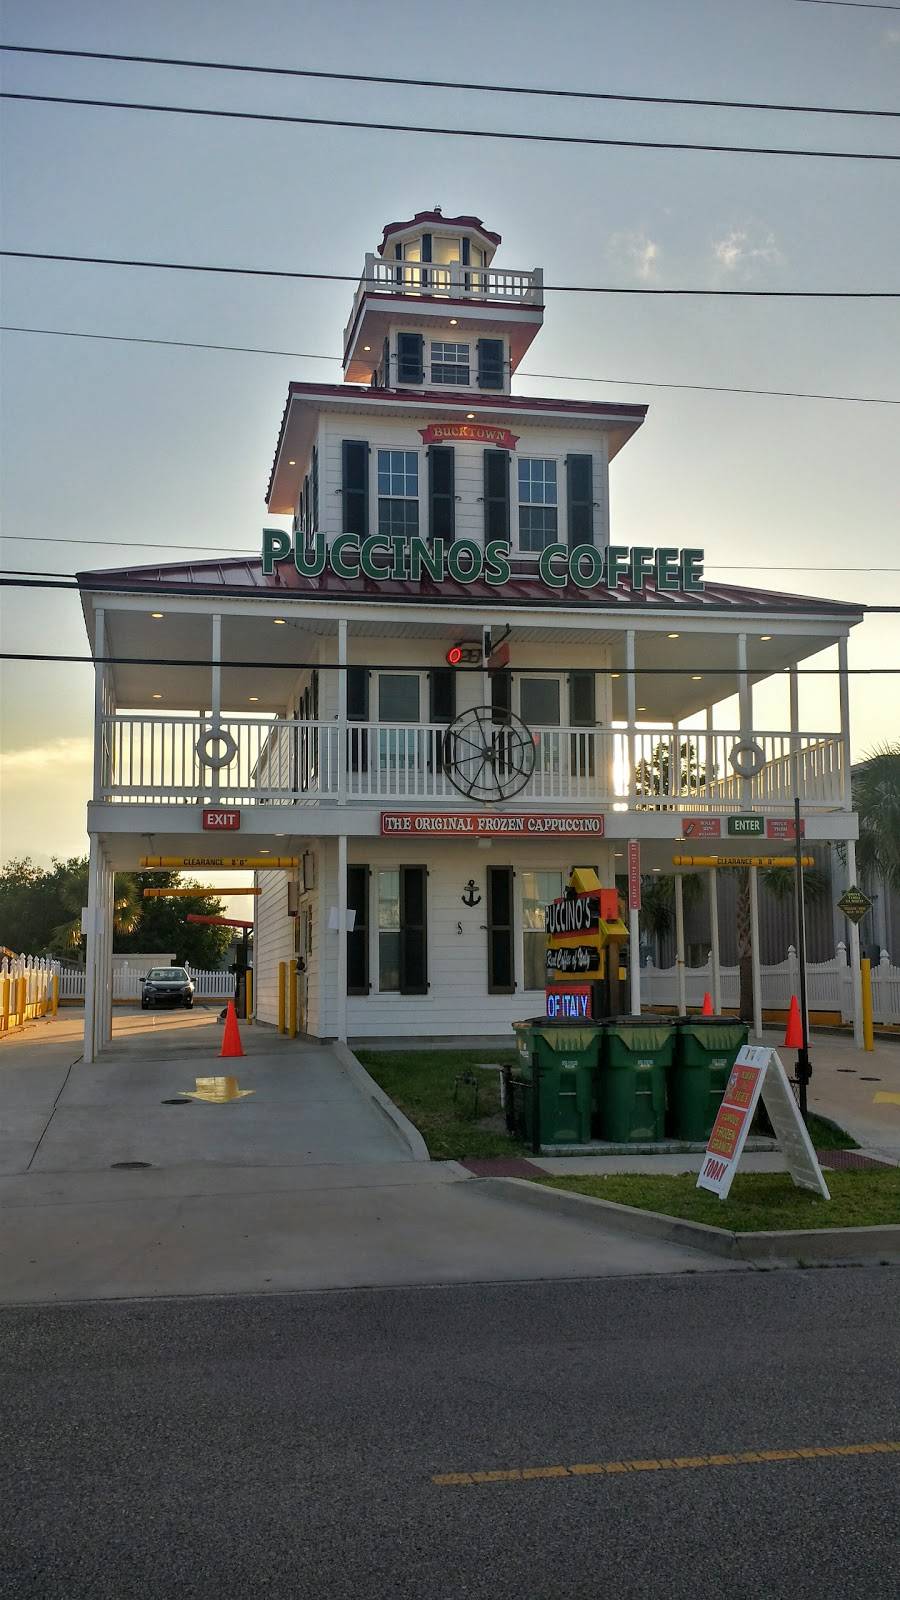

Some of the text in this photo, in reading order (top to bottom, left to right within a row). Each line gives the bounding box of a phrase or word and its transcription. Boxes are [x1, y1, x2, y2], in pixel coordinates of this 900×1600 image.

[433, 426, 506, 440] BUCKTOWN
[262, 527, 706, 592] PUCCINOS COFFEE
[207, 813, 237, 825] EXIT
[385, 817, 600, 833] THE ORIGINAL FROZEN CAPPUCCINO
[734, 820, 761, 832] ENTER
[183, 858, 225, 866] CLEARANCE
[545, 897, 591, 933] PUCCINO'S
[548, 995, 560, 1017] OF
[703, 1158, 729, 1183] TODAY
